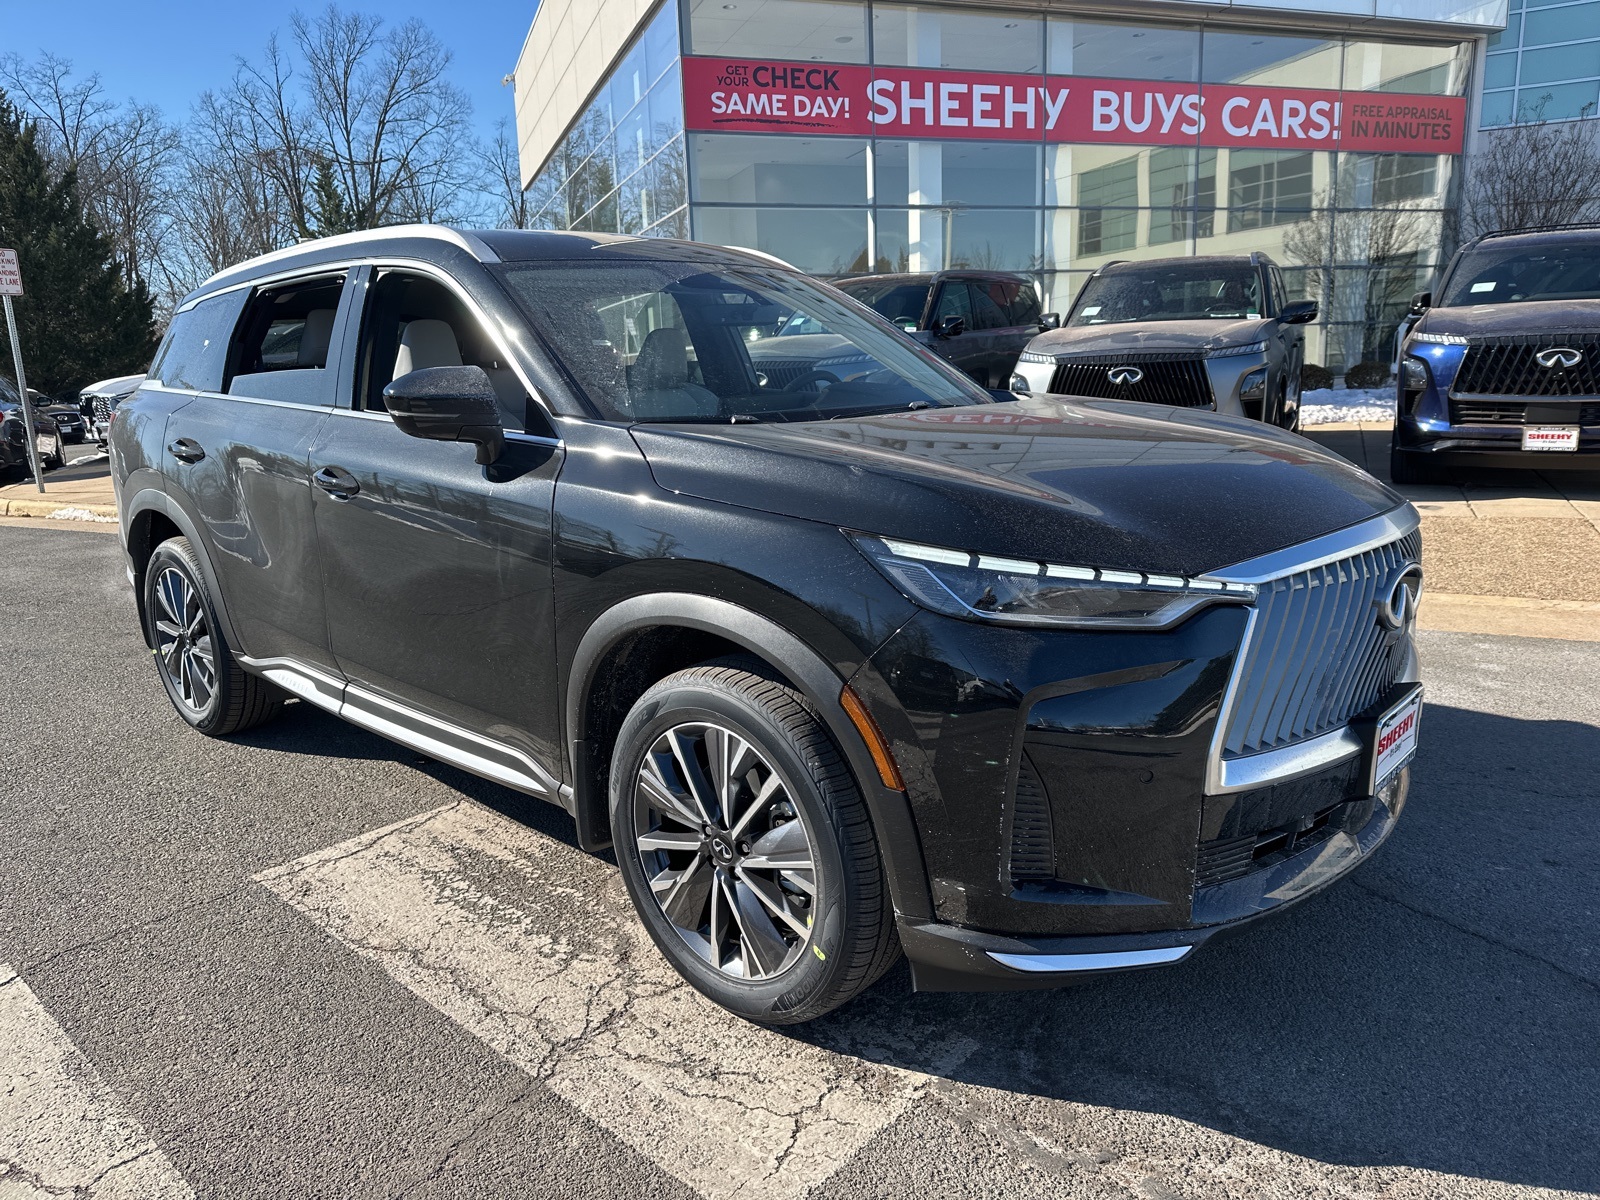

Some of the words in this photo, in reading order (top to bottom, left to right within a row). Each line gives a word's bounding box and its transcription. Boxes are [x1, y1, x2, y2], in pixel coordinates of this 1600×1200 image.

[716, 75, 749, 87] YOUR
[725, 65, 749, 76] GET
[752, 66, 840, 91] CHECK
[710, 91, 788, 117] SAME
[793, 95, 850, 119] DAY!
[865, 79, 1070, 130] SHEEHY
[1092, 90, 1206, 137] BUYS
[1221, 96, 1343, 141] CARS!
[1352, 104, 1384, 118] FREE
[1386, 105, 1453, 121] APPRAISAL
[1351, 120, 1369, 138] IN
[1372, 121, 1451, 140] MINUTES
[1377, 710, 1416, 757] SHEEHY
